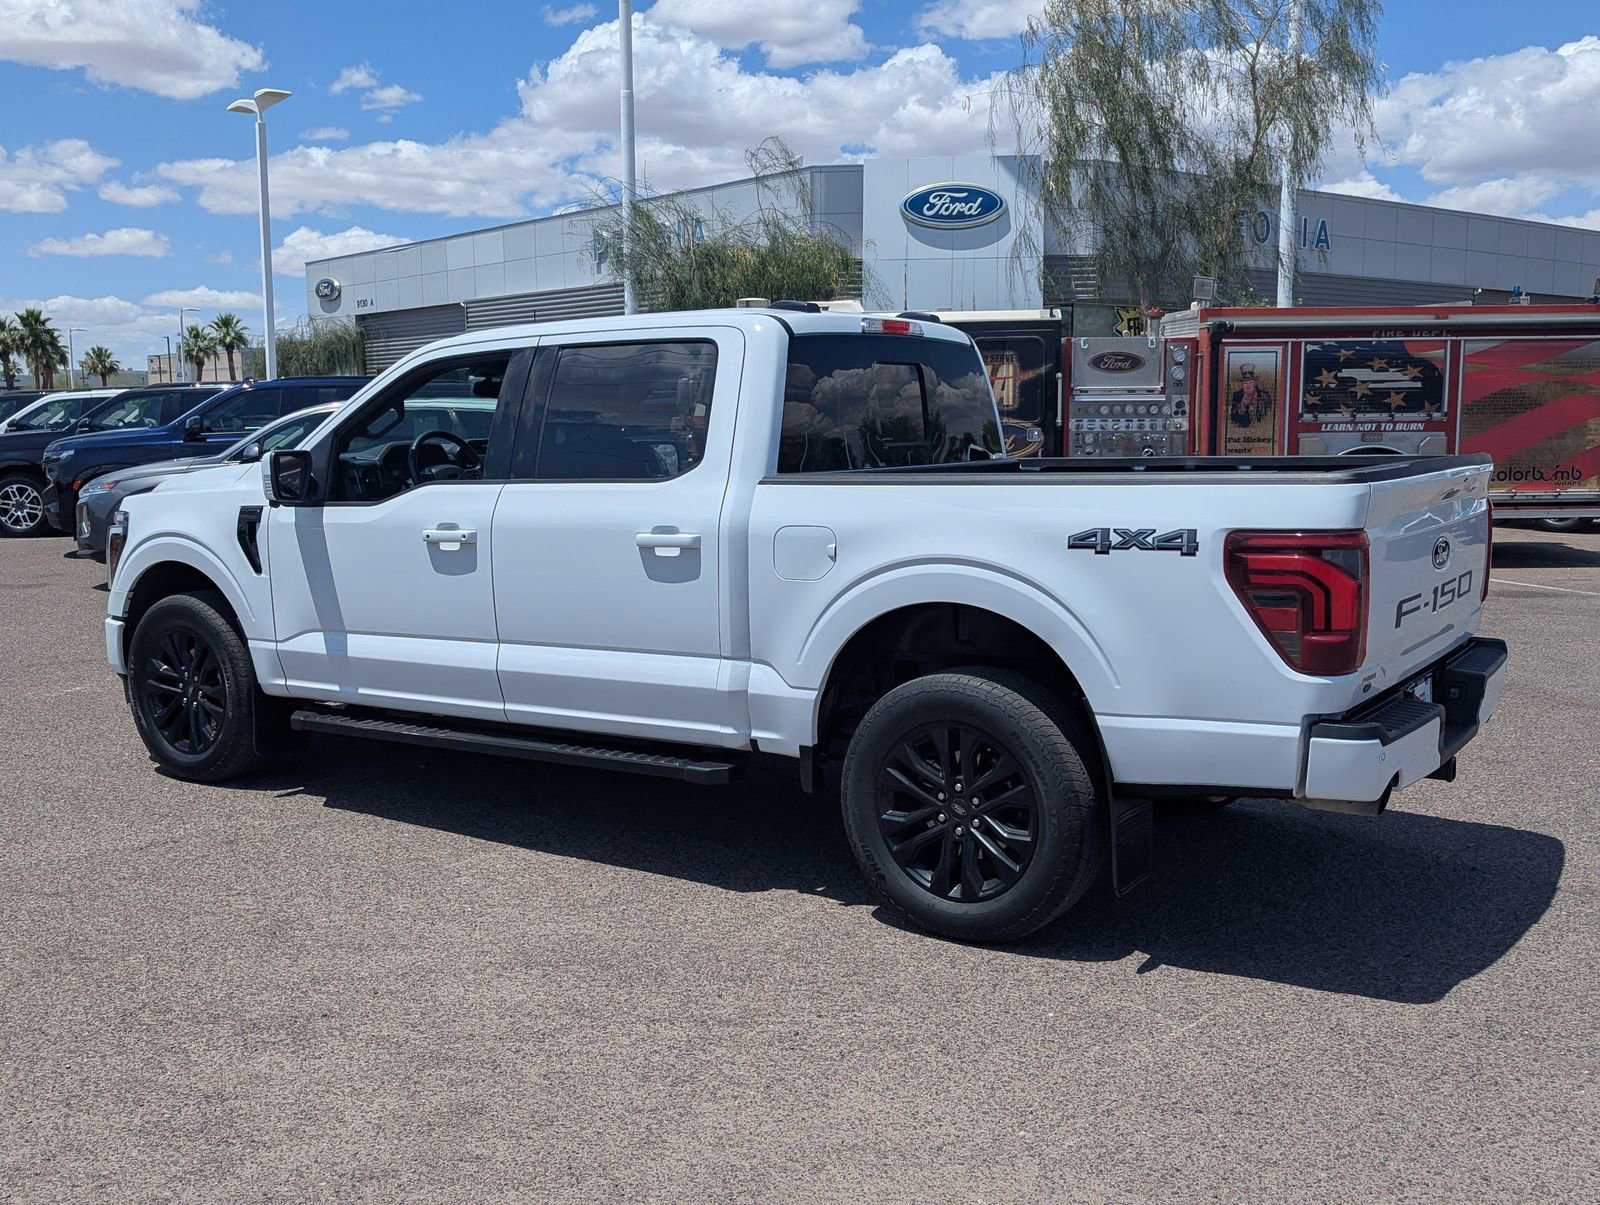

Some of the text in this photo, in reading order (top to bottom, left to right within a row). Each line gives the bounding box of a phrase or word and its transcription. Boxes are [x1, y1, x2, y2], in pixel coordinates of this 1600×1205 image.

[922, 191, 984, 216] Ford
[990, 353, 1016, 363] SERVE
[1100, 355, 1133, 369] Ford
[1321, 422, 1425, 431] LEARN NOT TO BURN
[1243, 436, 1272, 444] Hickey
[1394, 569, 1473, 630] F-150
